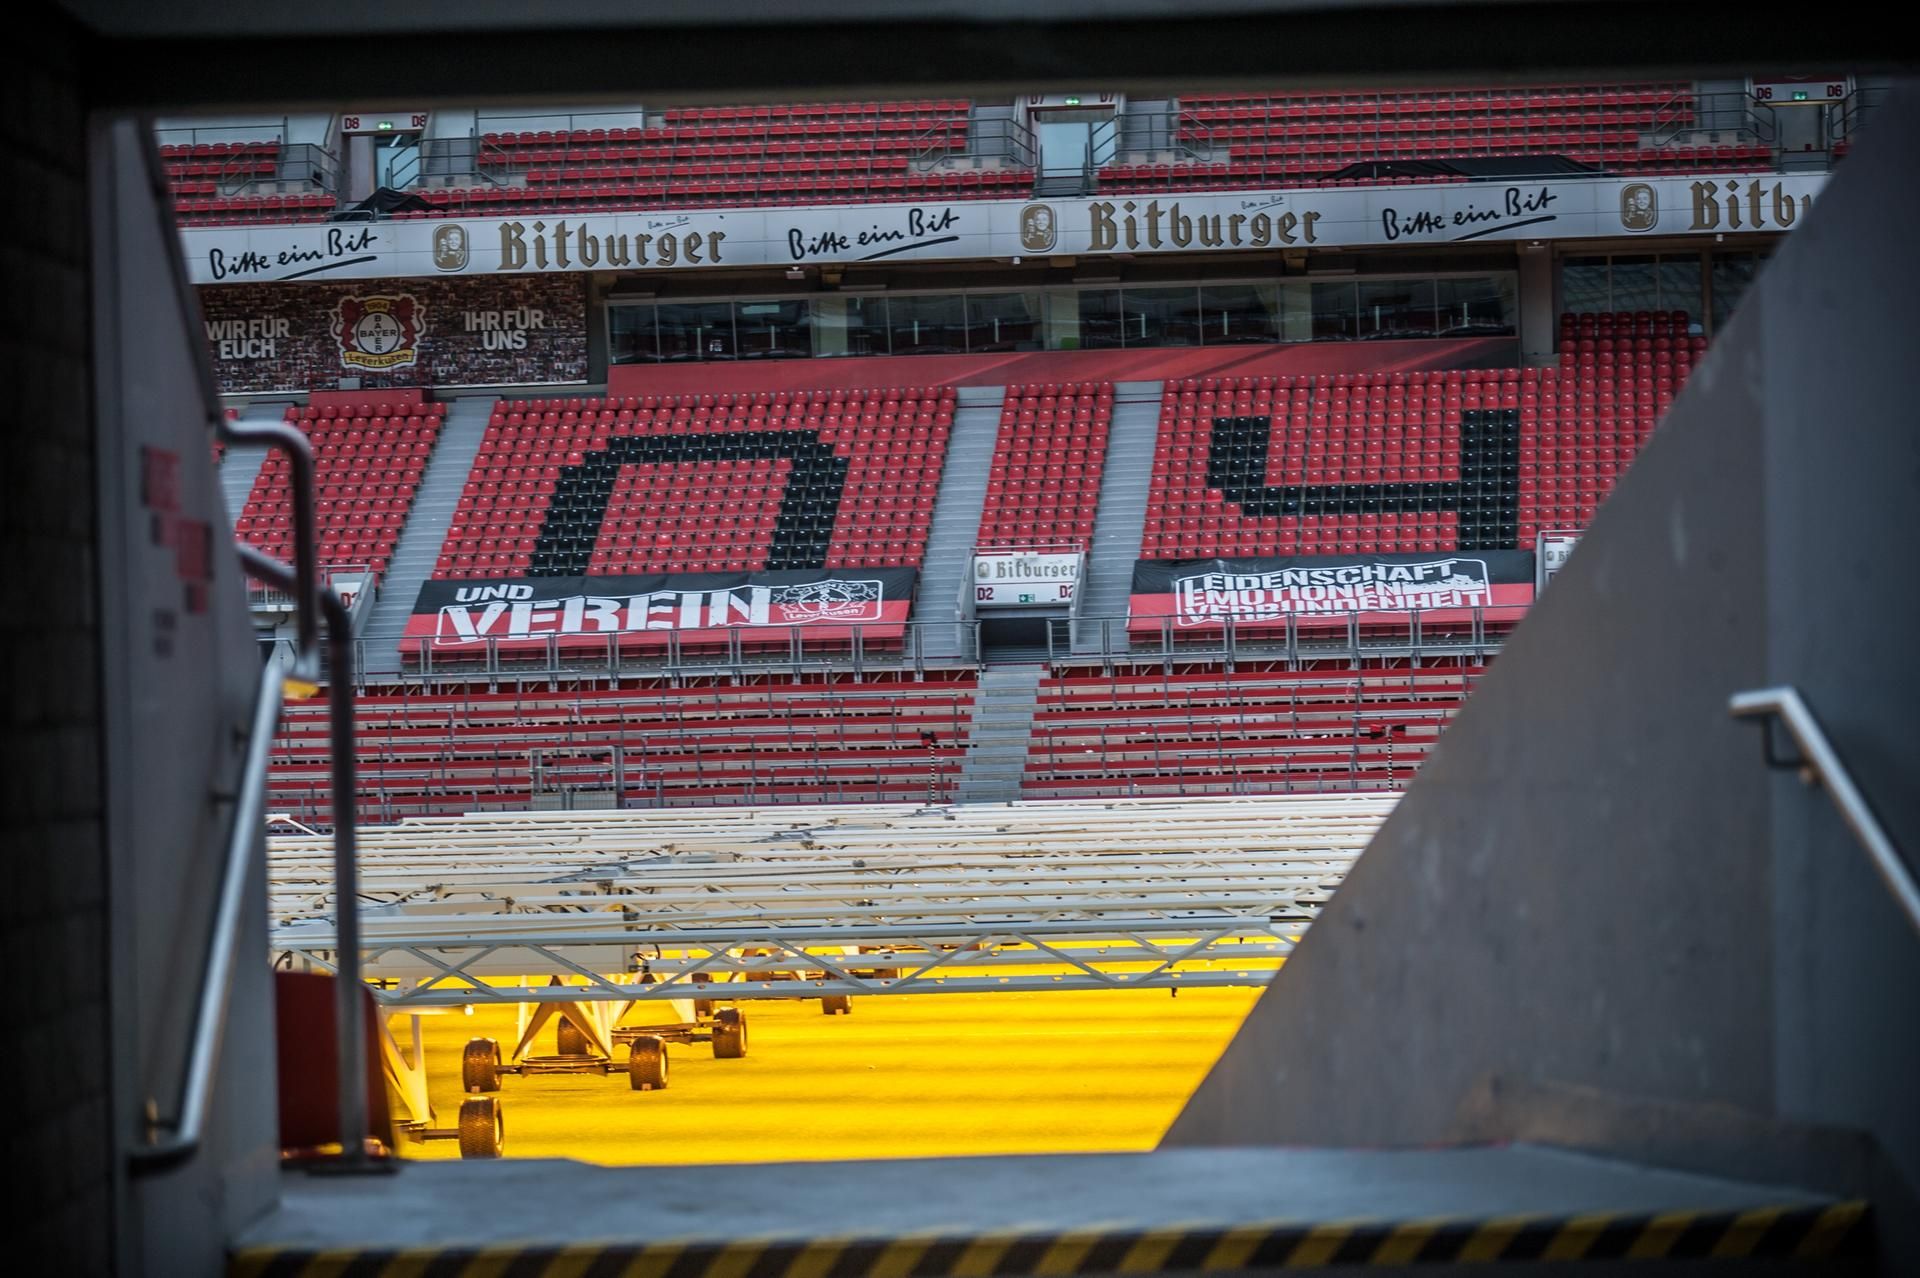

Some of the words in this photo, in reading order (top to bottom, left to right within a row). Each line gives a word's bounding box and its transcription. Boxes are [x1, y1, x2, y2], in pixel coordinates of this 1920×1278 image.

[1757, 88, 1772, 99] D6
[1827, 85, 1843, 97] D6
[344, 117, 360, 130] D8
[412, 115, 427, 127] D8
[1382, 208, 1446, 241] Bitte
[1452, 204, 1502, 226] ein
[1505, 186, 1558, 216] Bit
[788, 228, 850, 260] Bitte
[856, 224, 905, 246] ein
[908, 207, 960, 237] Bit
[1087, 200, 1322, 251] Bitburger
[209, 248, 272, 280] Bitte
[277, 244, 324, 266] ein
[327, 227, 378, 257] Bit
[497, 219, 727, 271] Bitburger
[206, 320, 247, 341] WIR
[250, 315, 290, 340] FÜR
[463, 311, 500, 332] IHR
[503, 306, 545, 330] FÜR
[360, 329, 397, 338] BAYER
[482, 331, 528, 350] UNS
[220, 339, 276, 360] EUCH
[349, 353, 409, 366] Leverkusen
[996, 561, 1076, 579] Bitburger
[455, 584, 534, 602] UND
[977, 587, 994, 600] D2
[1184, 561, 1457, 608] LEIDENSCHAFT
[1194, 580, 1404, 608] EMOTIONEN
[446, 587, 771, 641] VEREIN
[1184, 589, 1486, 623] VERBUNDENHEIT
